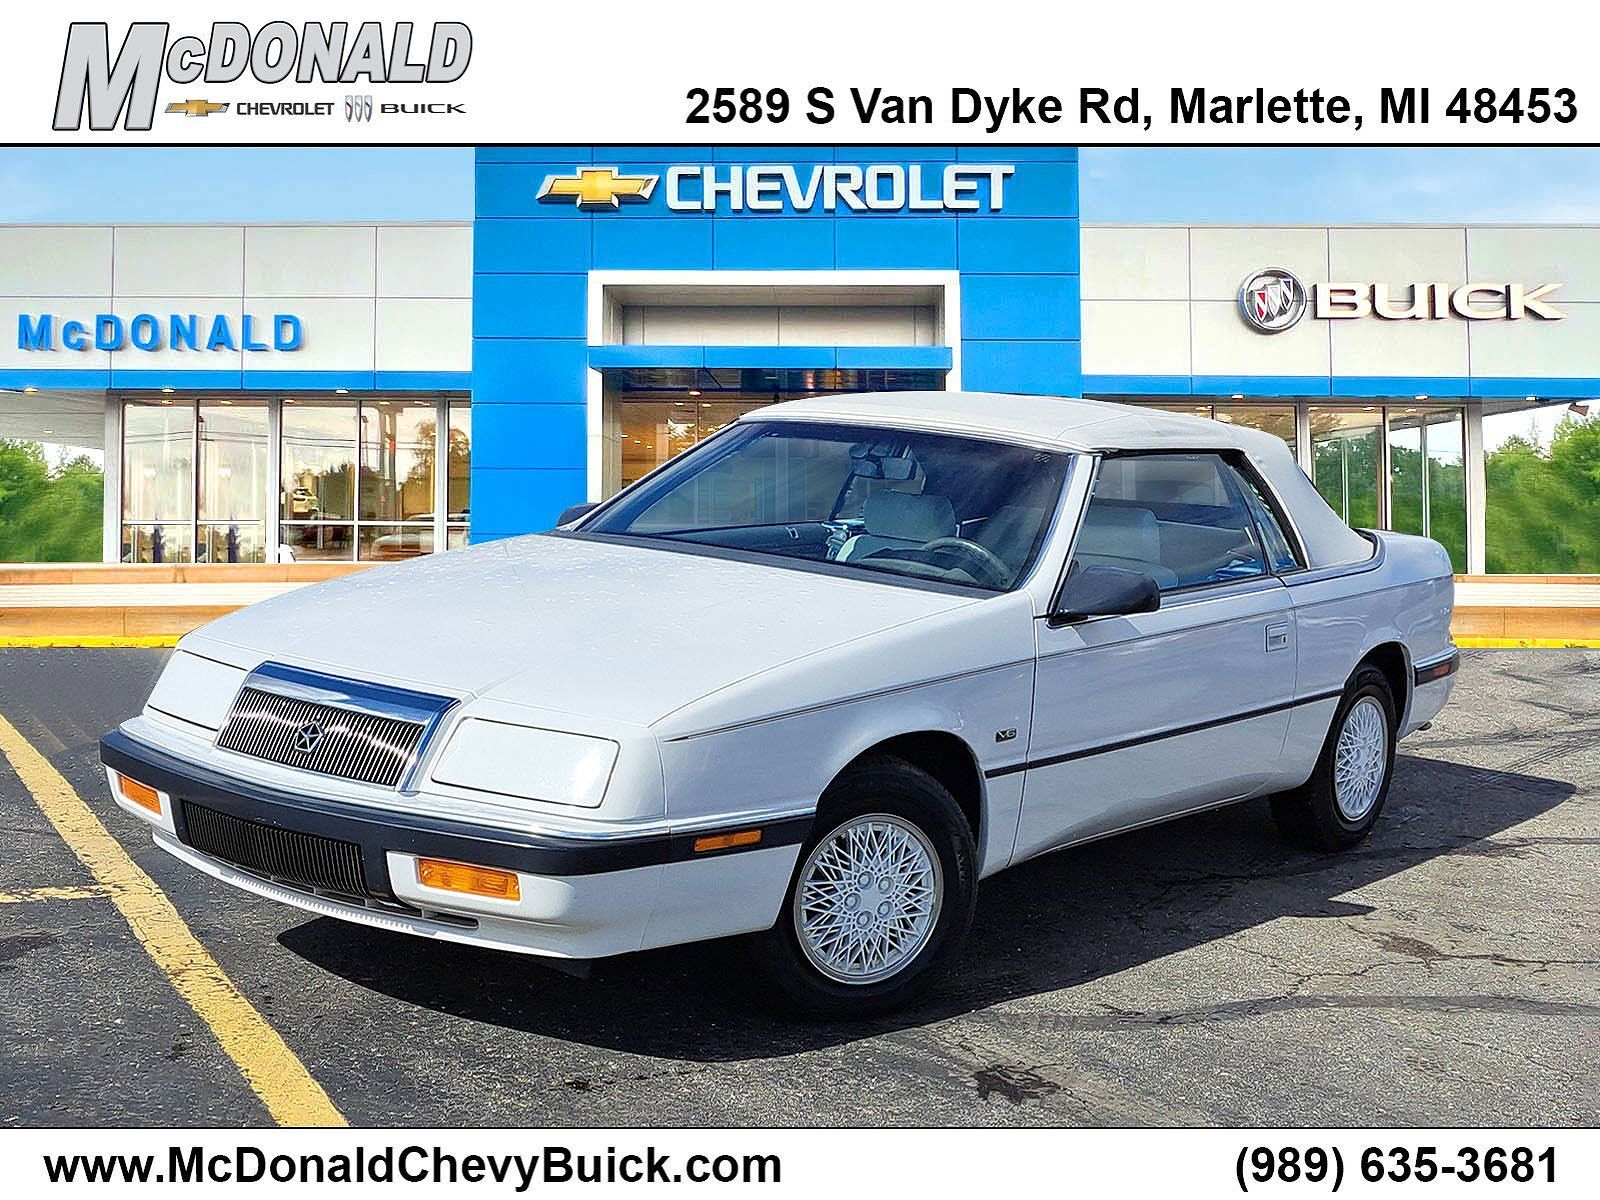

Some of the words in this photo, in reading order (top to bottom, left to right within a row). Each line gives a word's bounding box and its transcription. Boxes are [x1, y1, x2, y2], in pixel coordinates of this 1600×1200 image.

[665, 165, 1015, 212] CHEVROLET
[1312, 281, 1567, 321] BUICK
[17, 313, 305, 352] McDONALD
[997, 729, 1016, 740] V6
